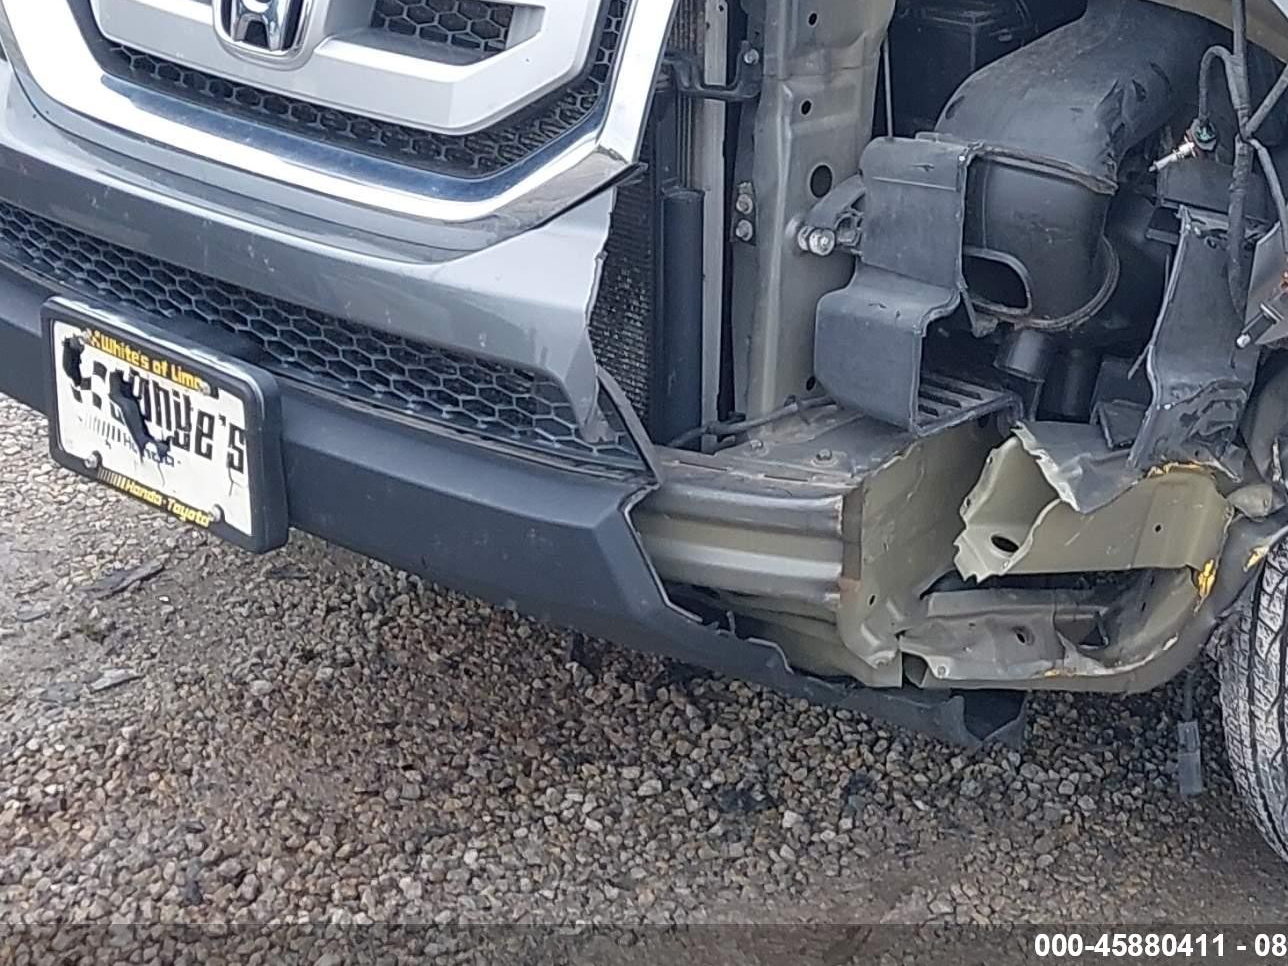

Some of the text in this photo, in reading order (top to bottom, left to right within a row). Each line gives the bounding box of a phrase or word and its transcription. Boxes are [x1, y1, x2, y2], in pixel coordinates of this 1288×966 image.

[100, 335, 149, 371] White's
[152, 360, 168, 377] of
[125, 480, 210, 528] Honda Toyota
